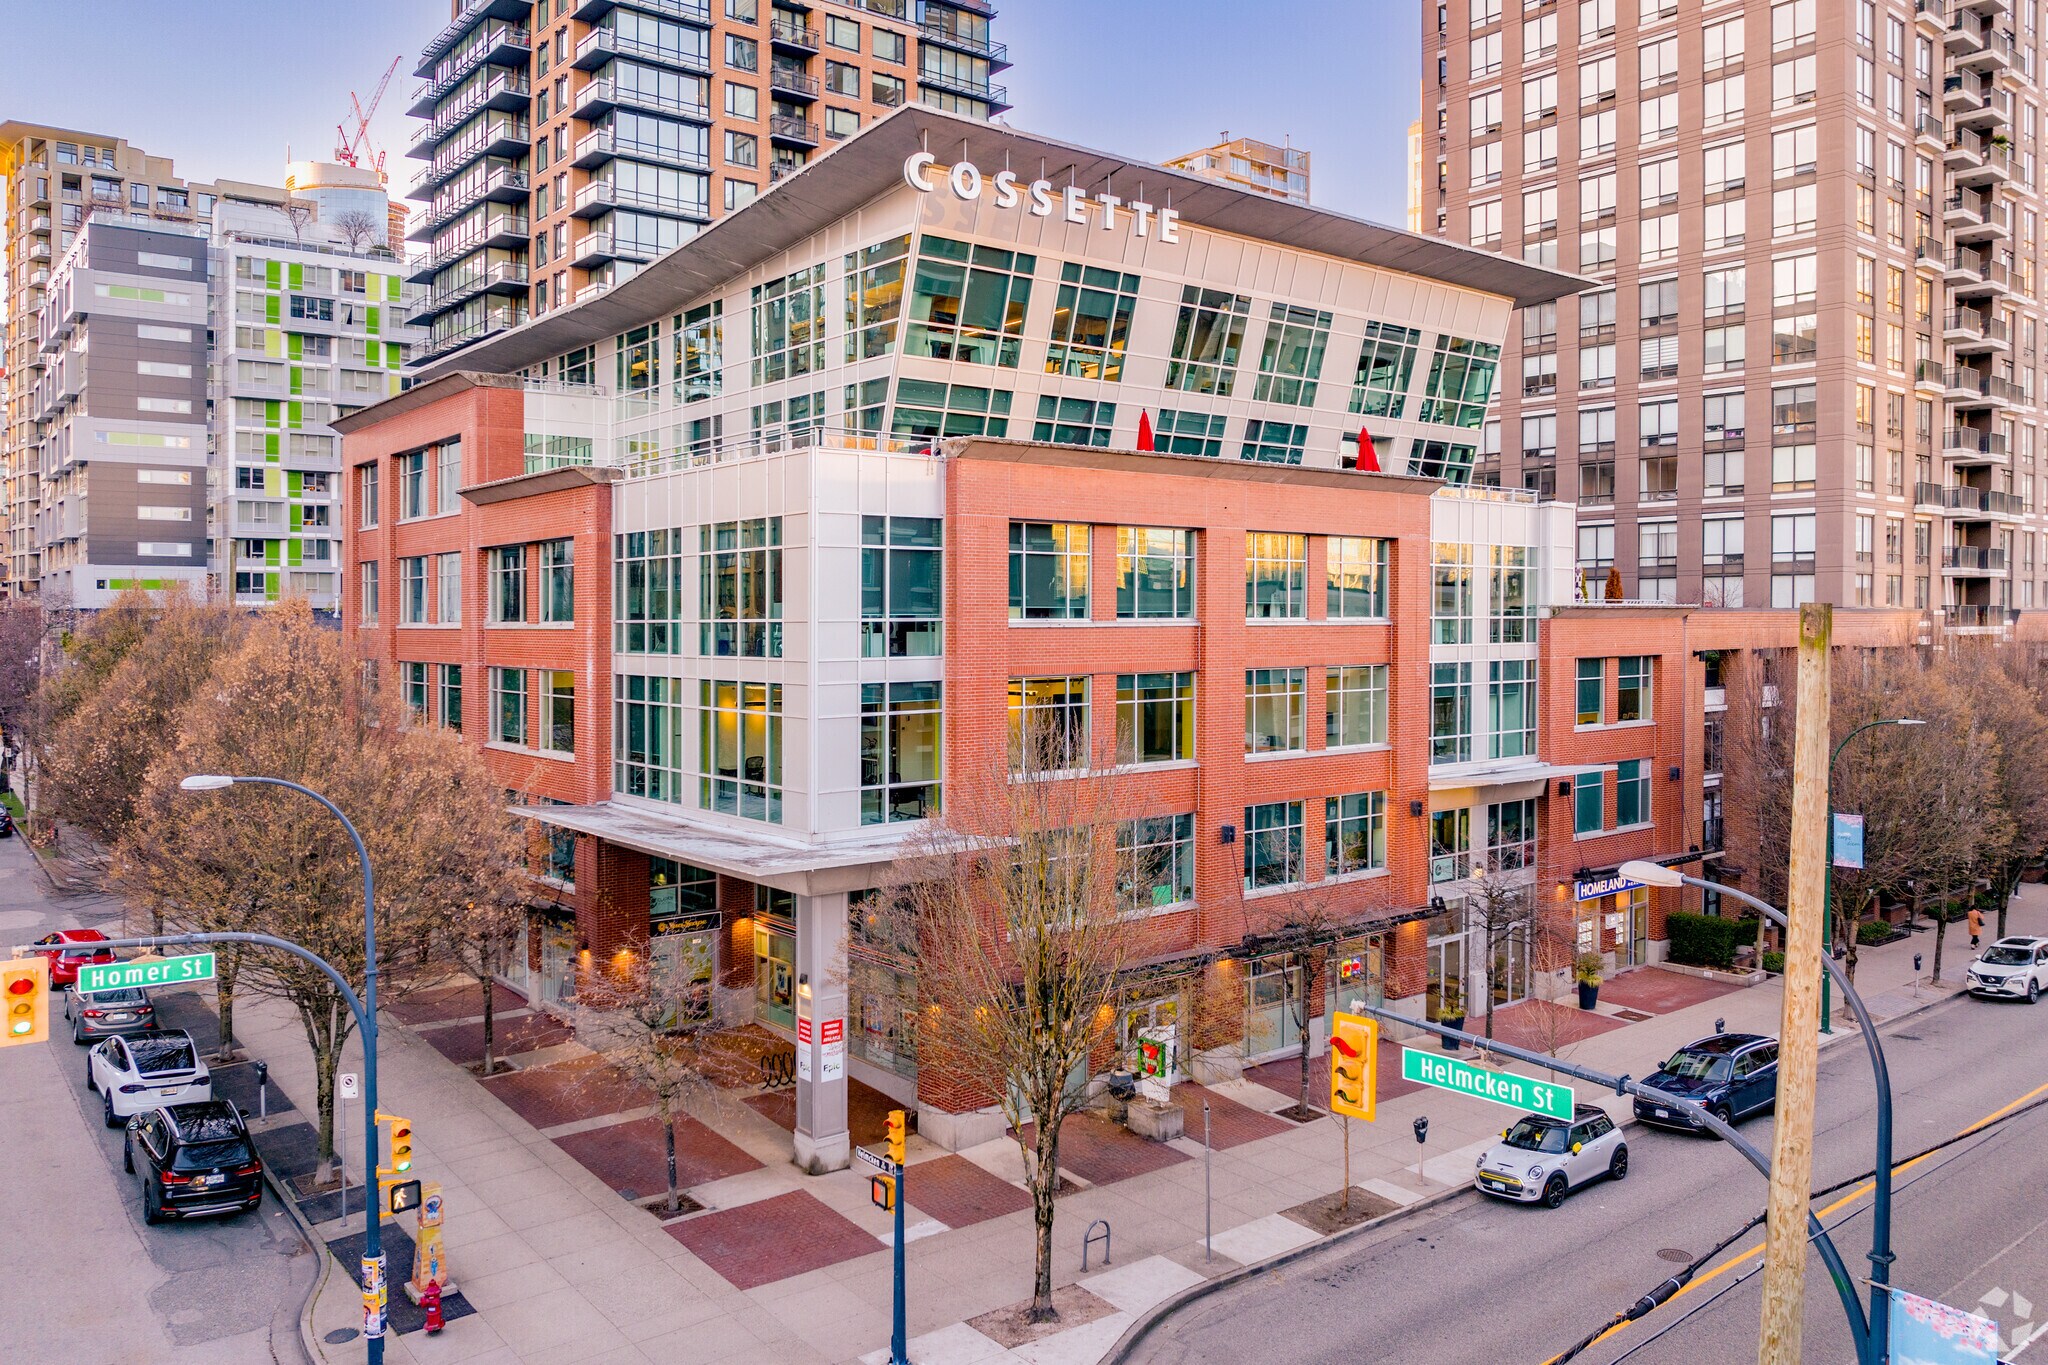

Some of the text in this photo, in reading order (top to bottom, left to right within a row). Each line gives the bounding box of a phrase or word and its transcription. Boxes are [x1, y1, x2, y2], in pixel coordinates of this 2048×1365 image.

[903, 151, 1180, 244] COSSETTE
[1580, 877, 1626, 897] HOMELAND
[91, 958, 203, 988] Homer St
[823, 1062, 841, 1073] Epic
[1421, 1057, 1554, 1111] Helmcken St
